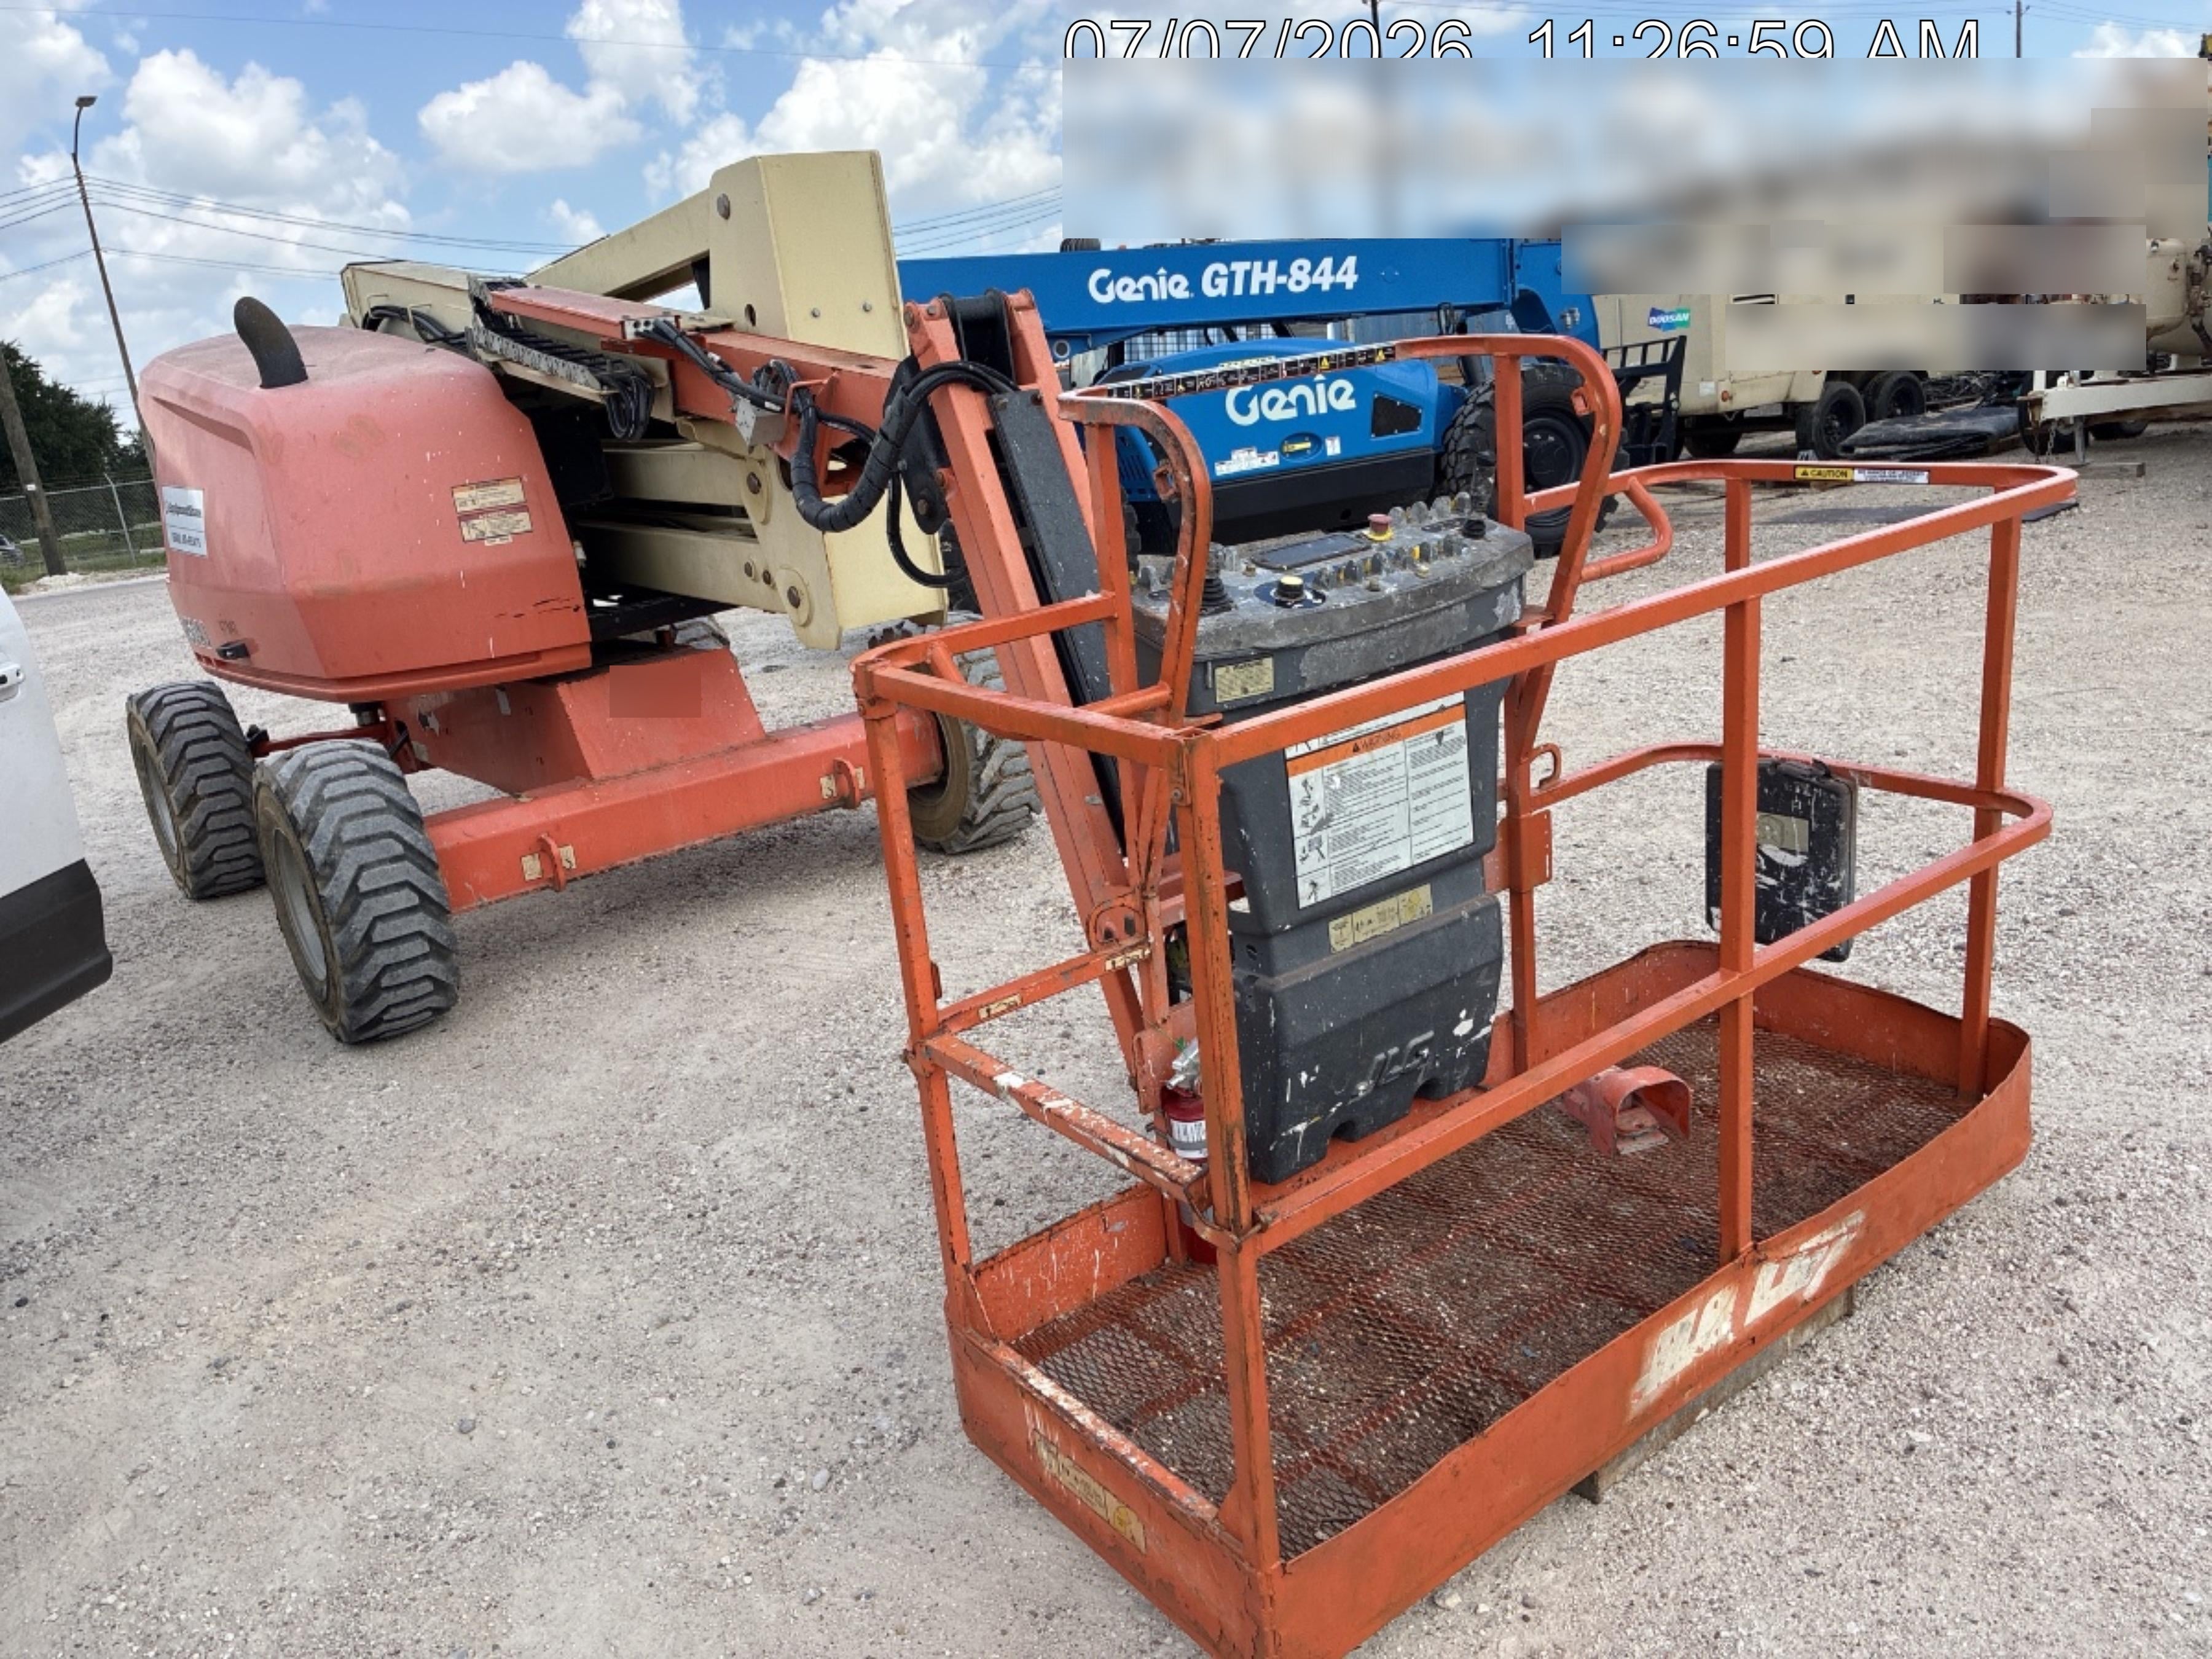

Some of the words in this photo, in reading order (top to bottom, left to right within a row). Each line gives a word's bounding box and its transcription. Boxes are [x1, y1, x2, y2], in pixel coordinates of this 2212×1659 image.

[1088, 267, 1191, 304] Genie
[1201, 256, 1359, 297] GTH-844
[1649, 313, 1689, 325] DOOSAN
[1225, 374, 1357, 426] Genie
[1810, 469, 1848, 478] CAUTION
